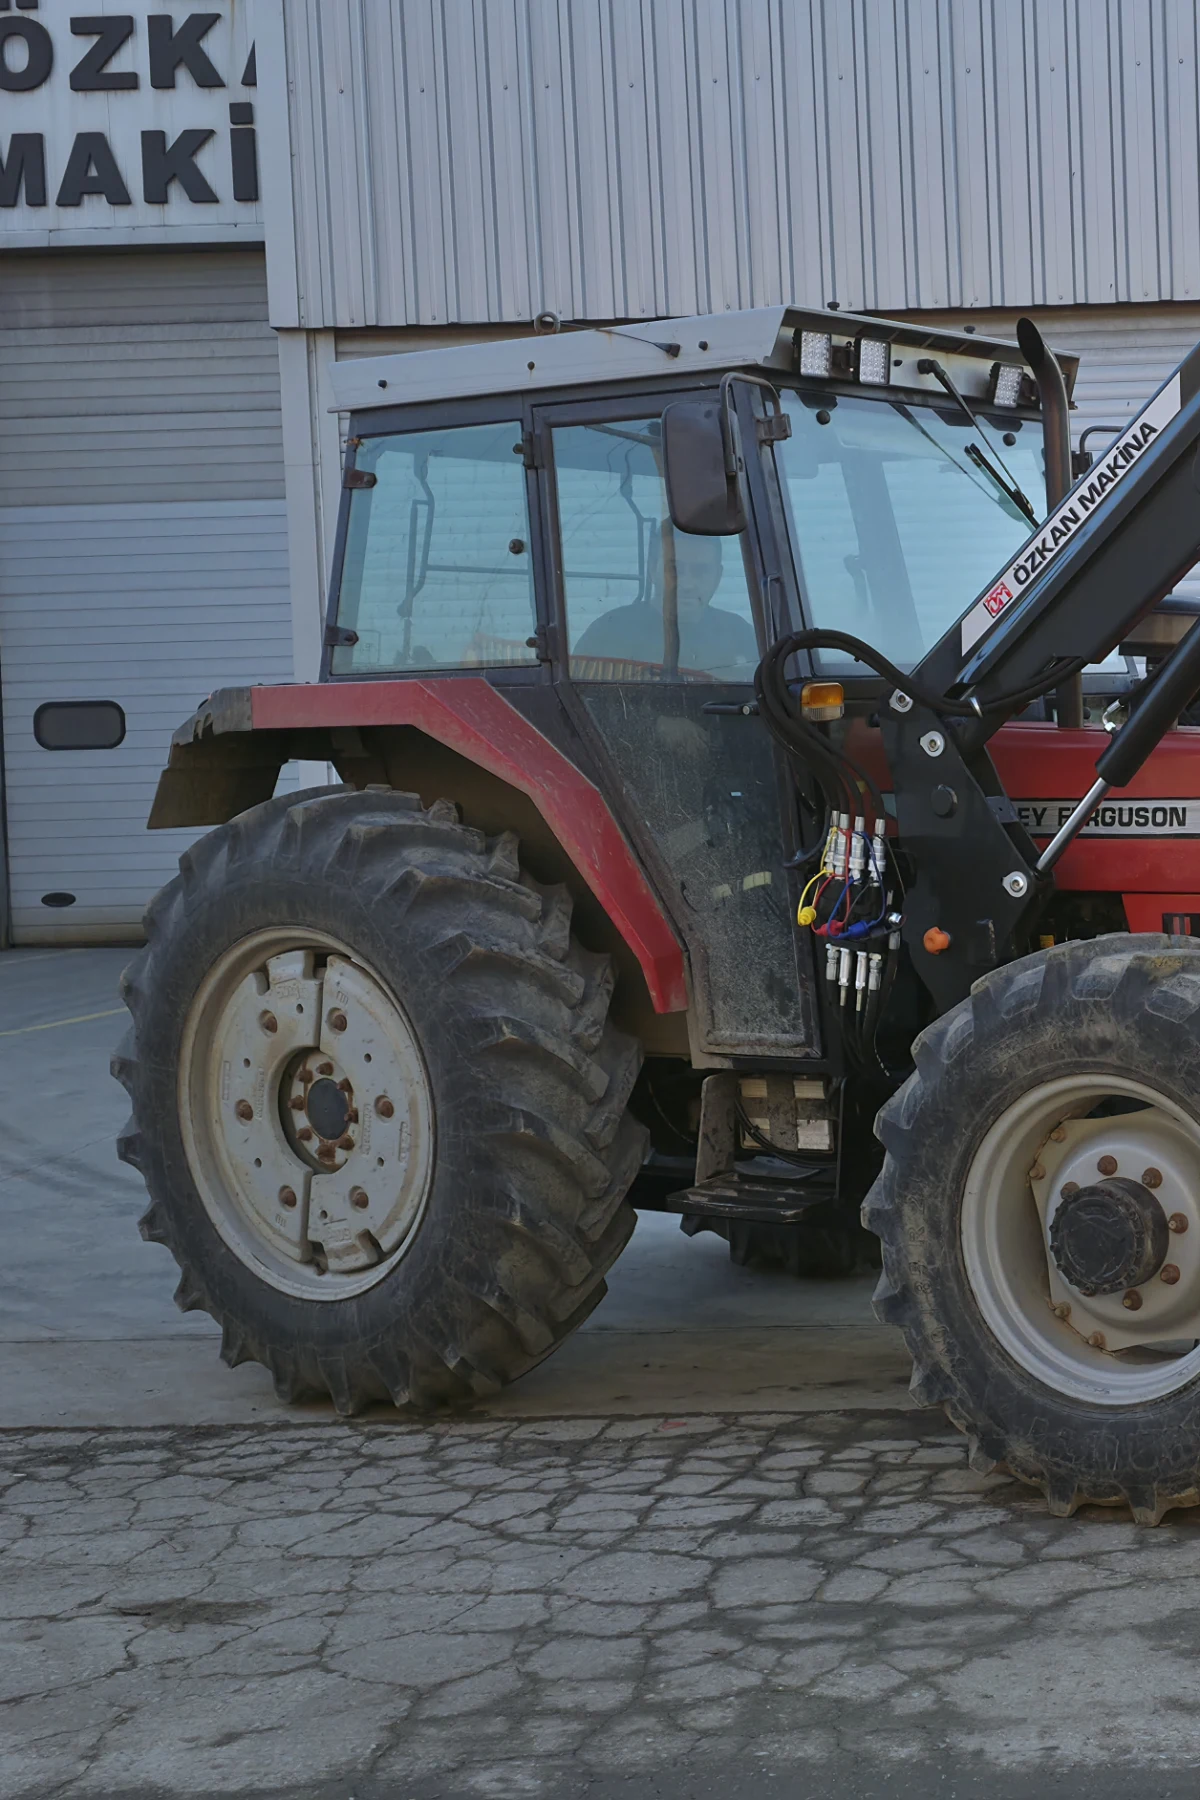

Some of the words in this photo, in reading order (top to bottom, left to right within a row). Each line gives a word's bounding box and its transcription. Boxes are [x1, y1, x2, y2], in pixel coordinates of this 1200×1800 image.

[0, 0, 257, 91] ÖZK
[1013, 506, 1080, 586] ÖZKAN
[1077, 422, 1159, 512] MAKİNA
[1058, 806, 1187, 827] FRGUSON
